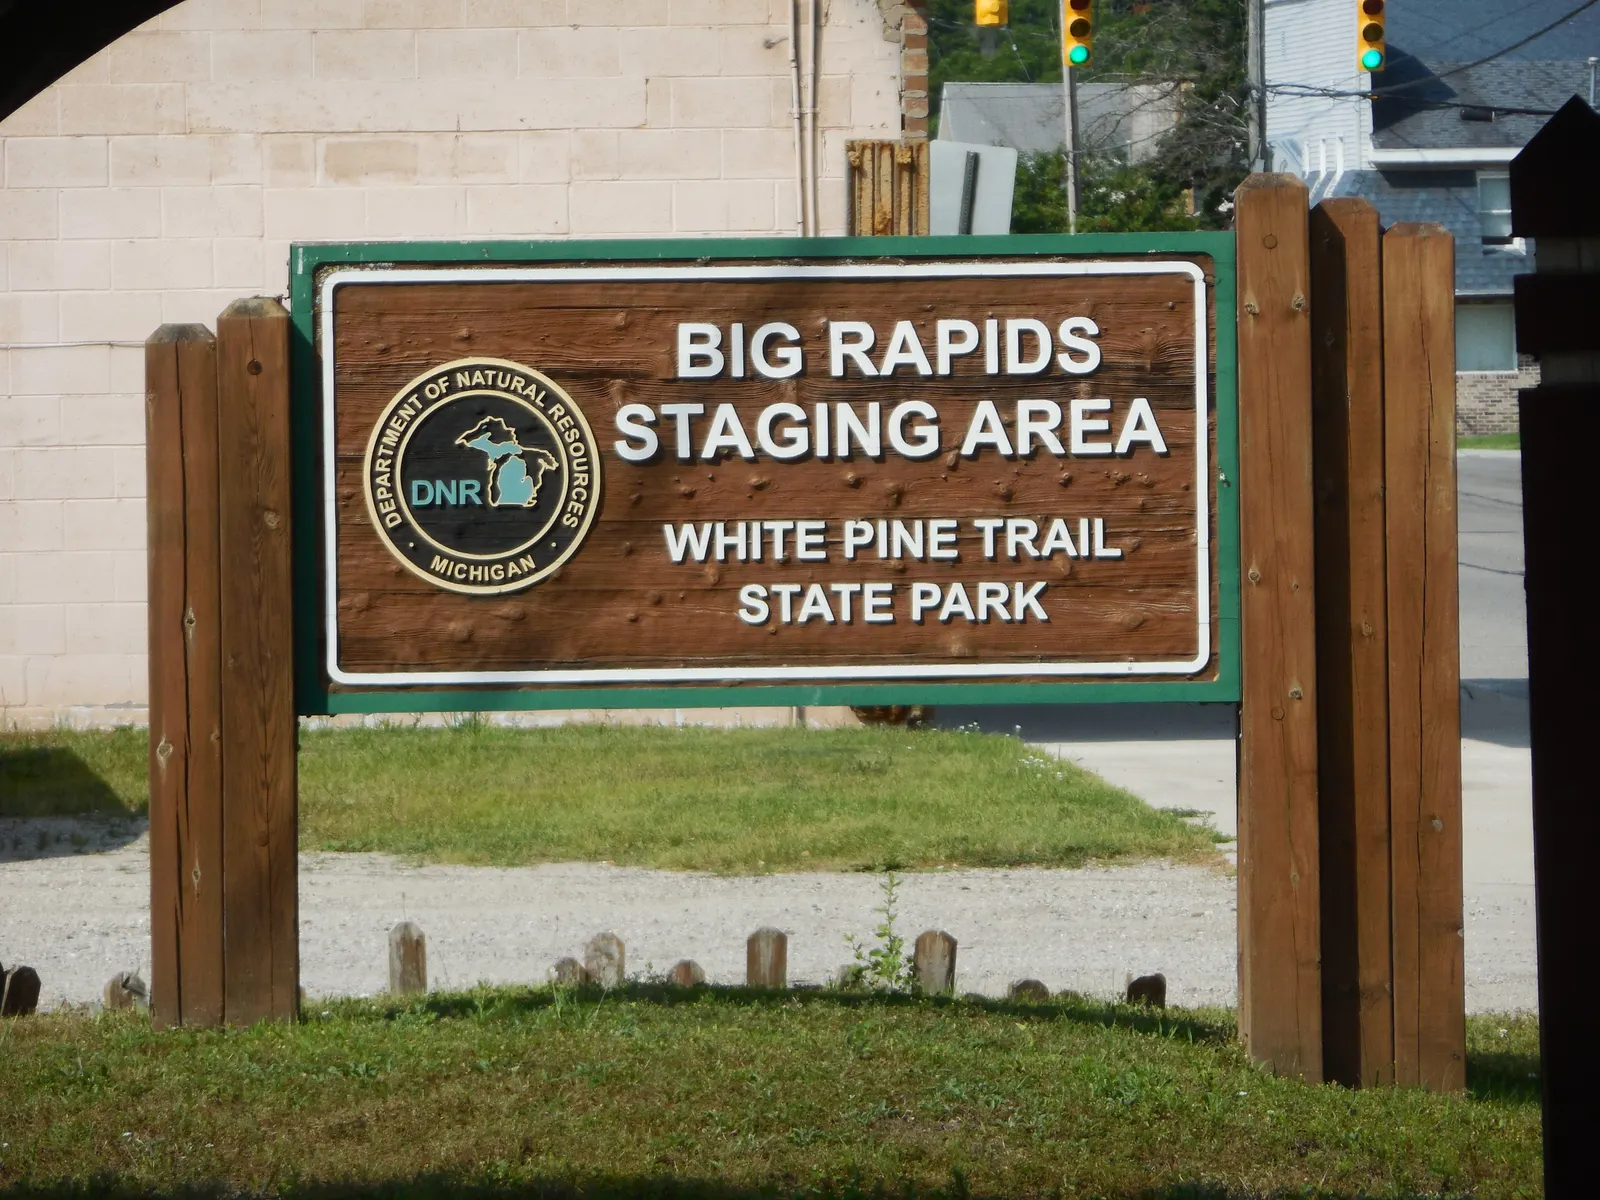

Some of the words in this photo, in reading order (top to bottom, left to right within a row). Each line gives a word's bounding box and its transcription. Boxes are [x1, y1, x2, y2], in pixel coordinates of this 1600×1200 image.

[677, 322, 802, 378] BIG
[829, 316, 1101, 376] RAPIDS
[375, 394, 423, 528] DEPARTMENT
[425, 376, 450, 399] OF
[457, 370, 546, 407] NATURAL
[548, 403, 589, 528] RESOURCES
[614, 401, 939, 461] STAGING
[961, 397, 1167, 455] AREA
[411, 480, 482, 506] DNR
[664, 521, 826, 561] WHITE
[845, 519, 958, 558] PINE
[975, 517, 1122, 557] TRAIL
[430, 554, 536, 581] MICHIGAN
[738, 582, 894, 624] STATE
[912, 581, 1049, 621] PARK
